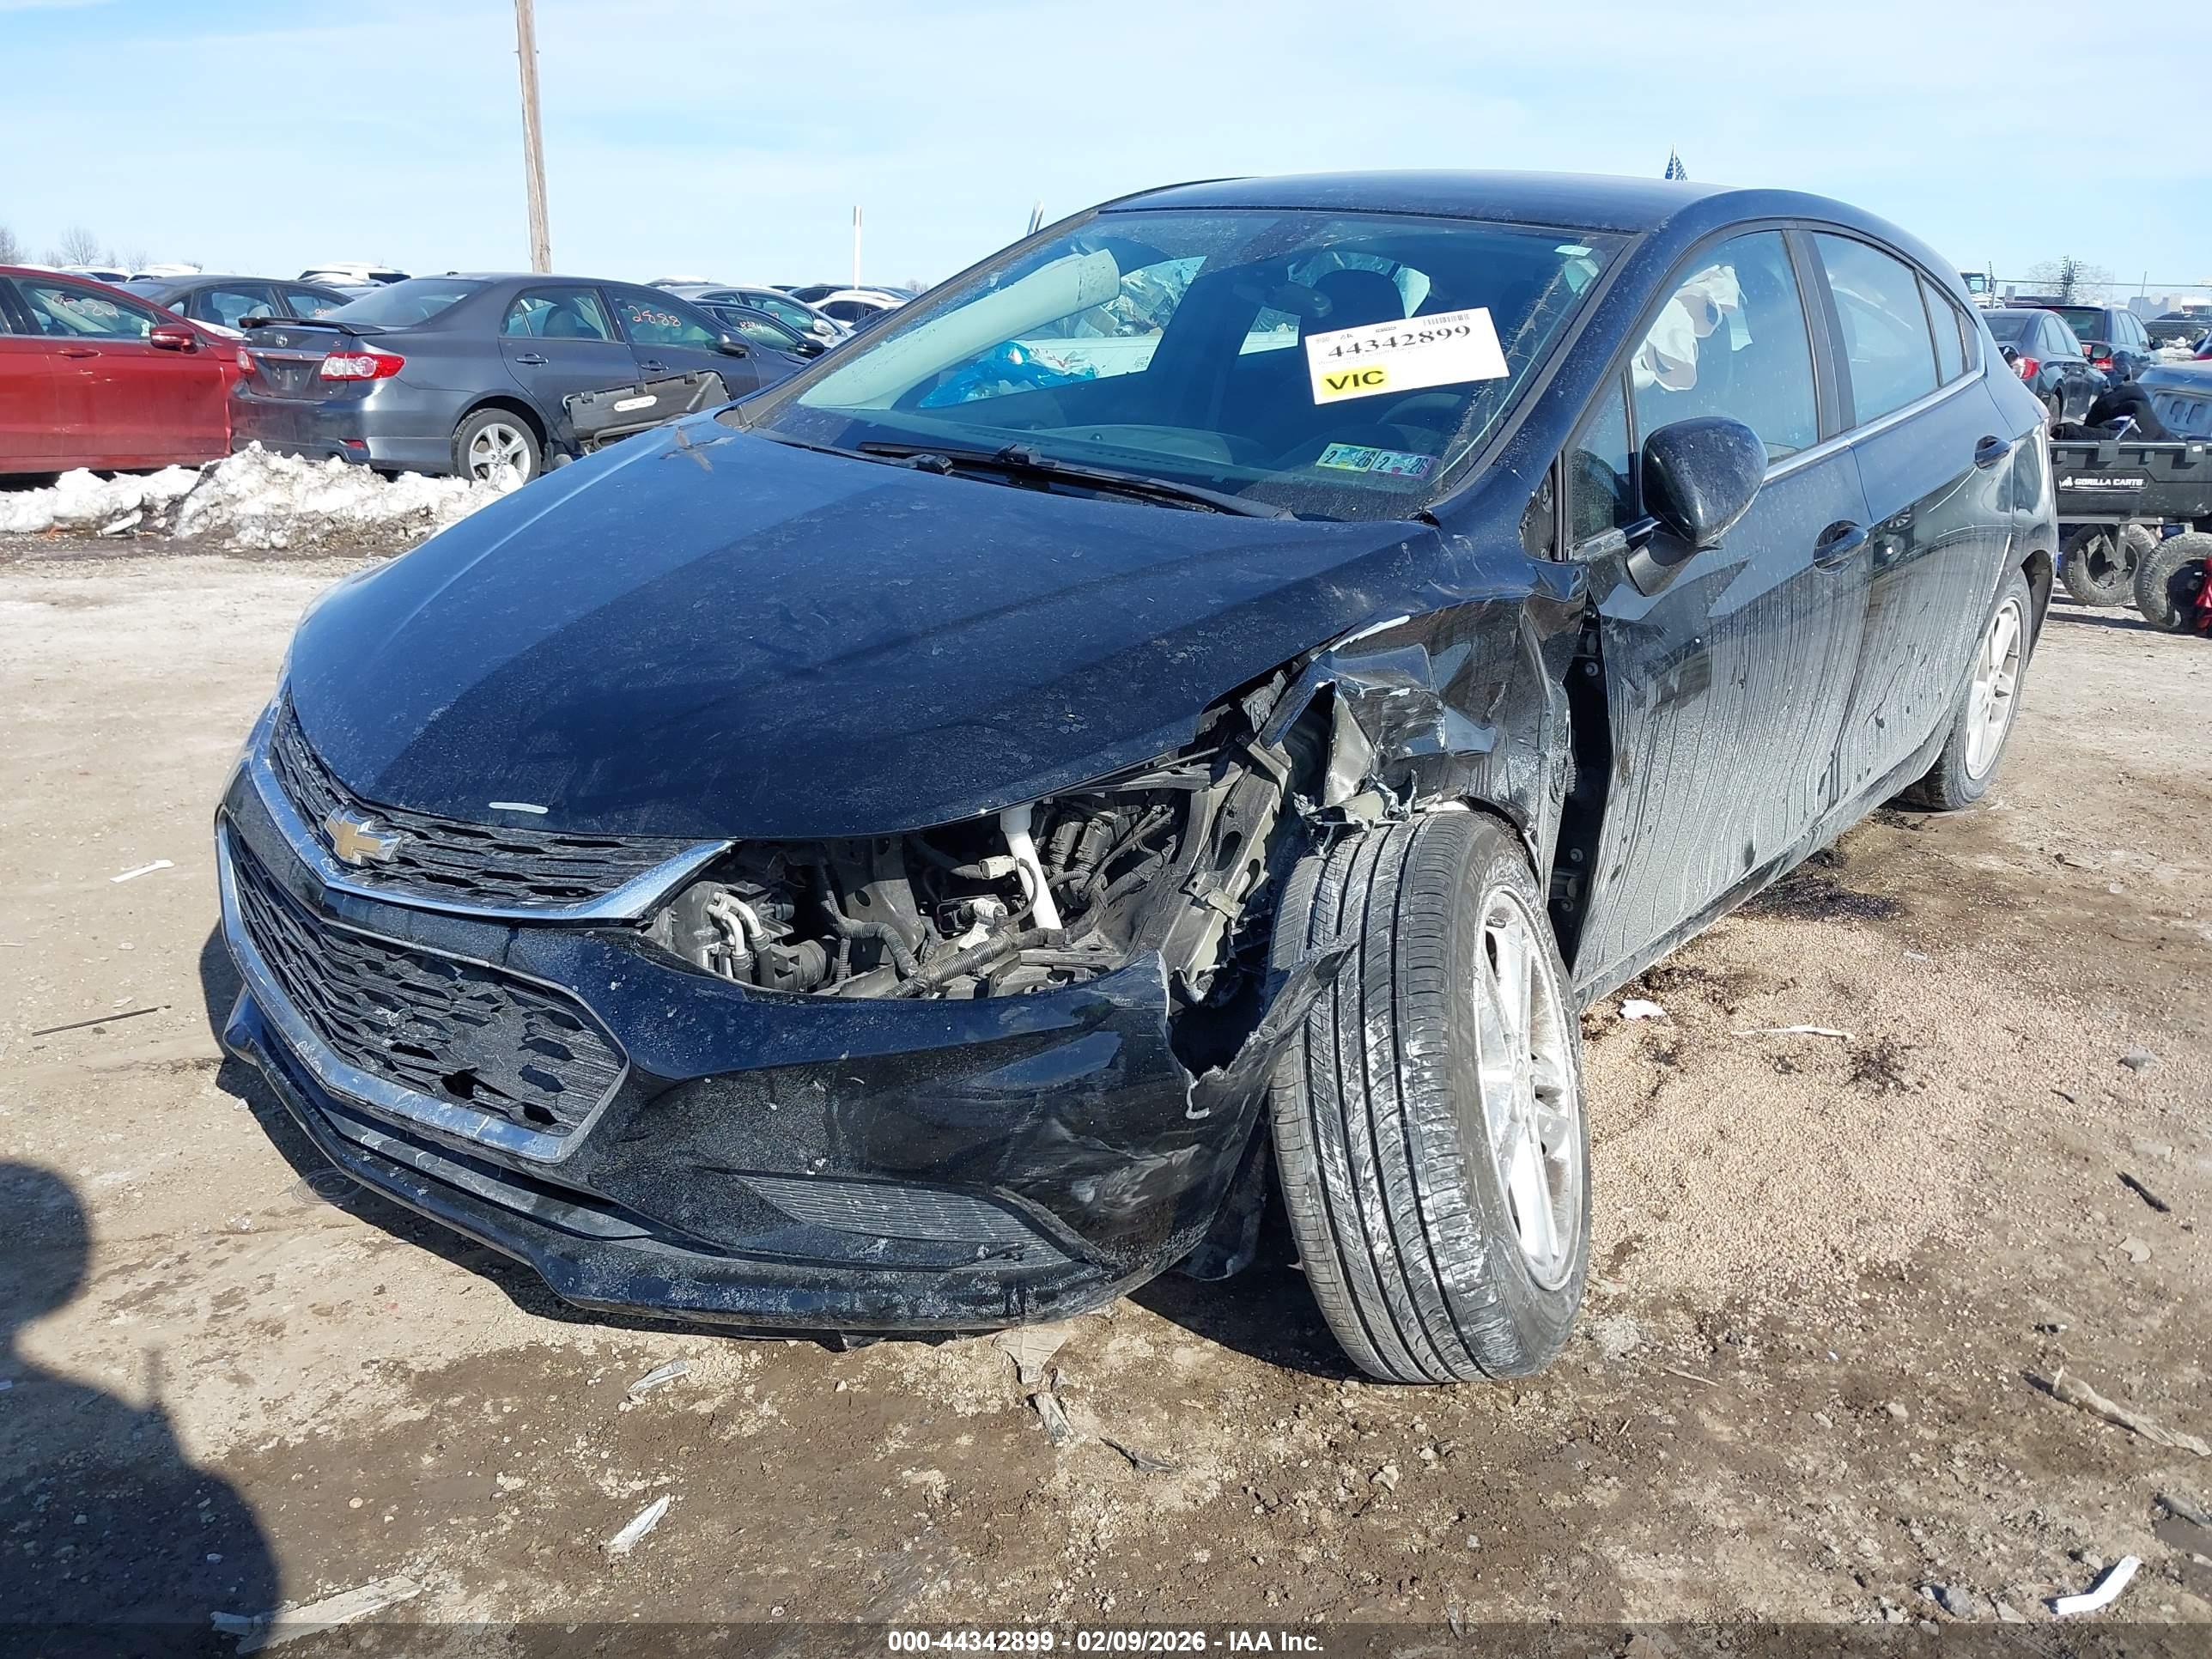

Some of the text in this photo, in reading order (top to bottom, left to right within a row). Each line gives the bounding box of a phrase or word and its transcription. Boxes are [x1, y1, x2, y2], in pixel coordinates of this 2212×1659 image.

[1328, 325, 1471, 357] 44342899
[1326, 370, 1384, 390] VIC
[2075, 477, 2112, 486] GORILLA
